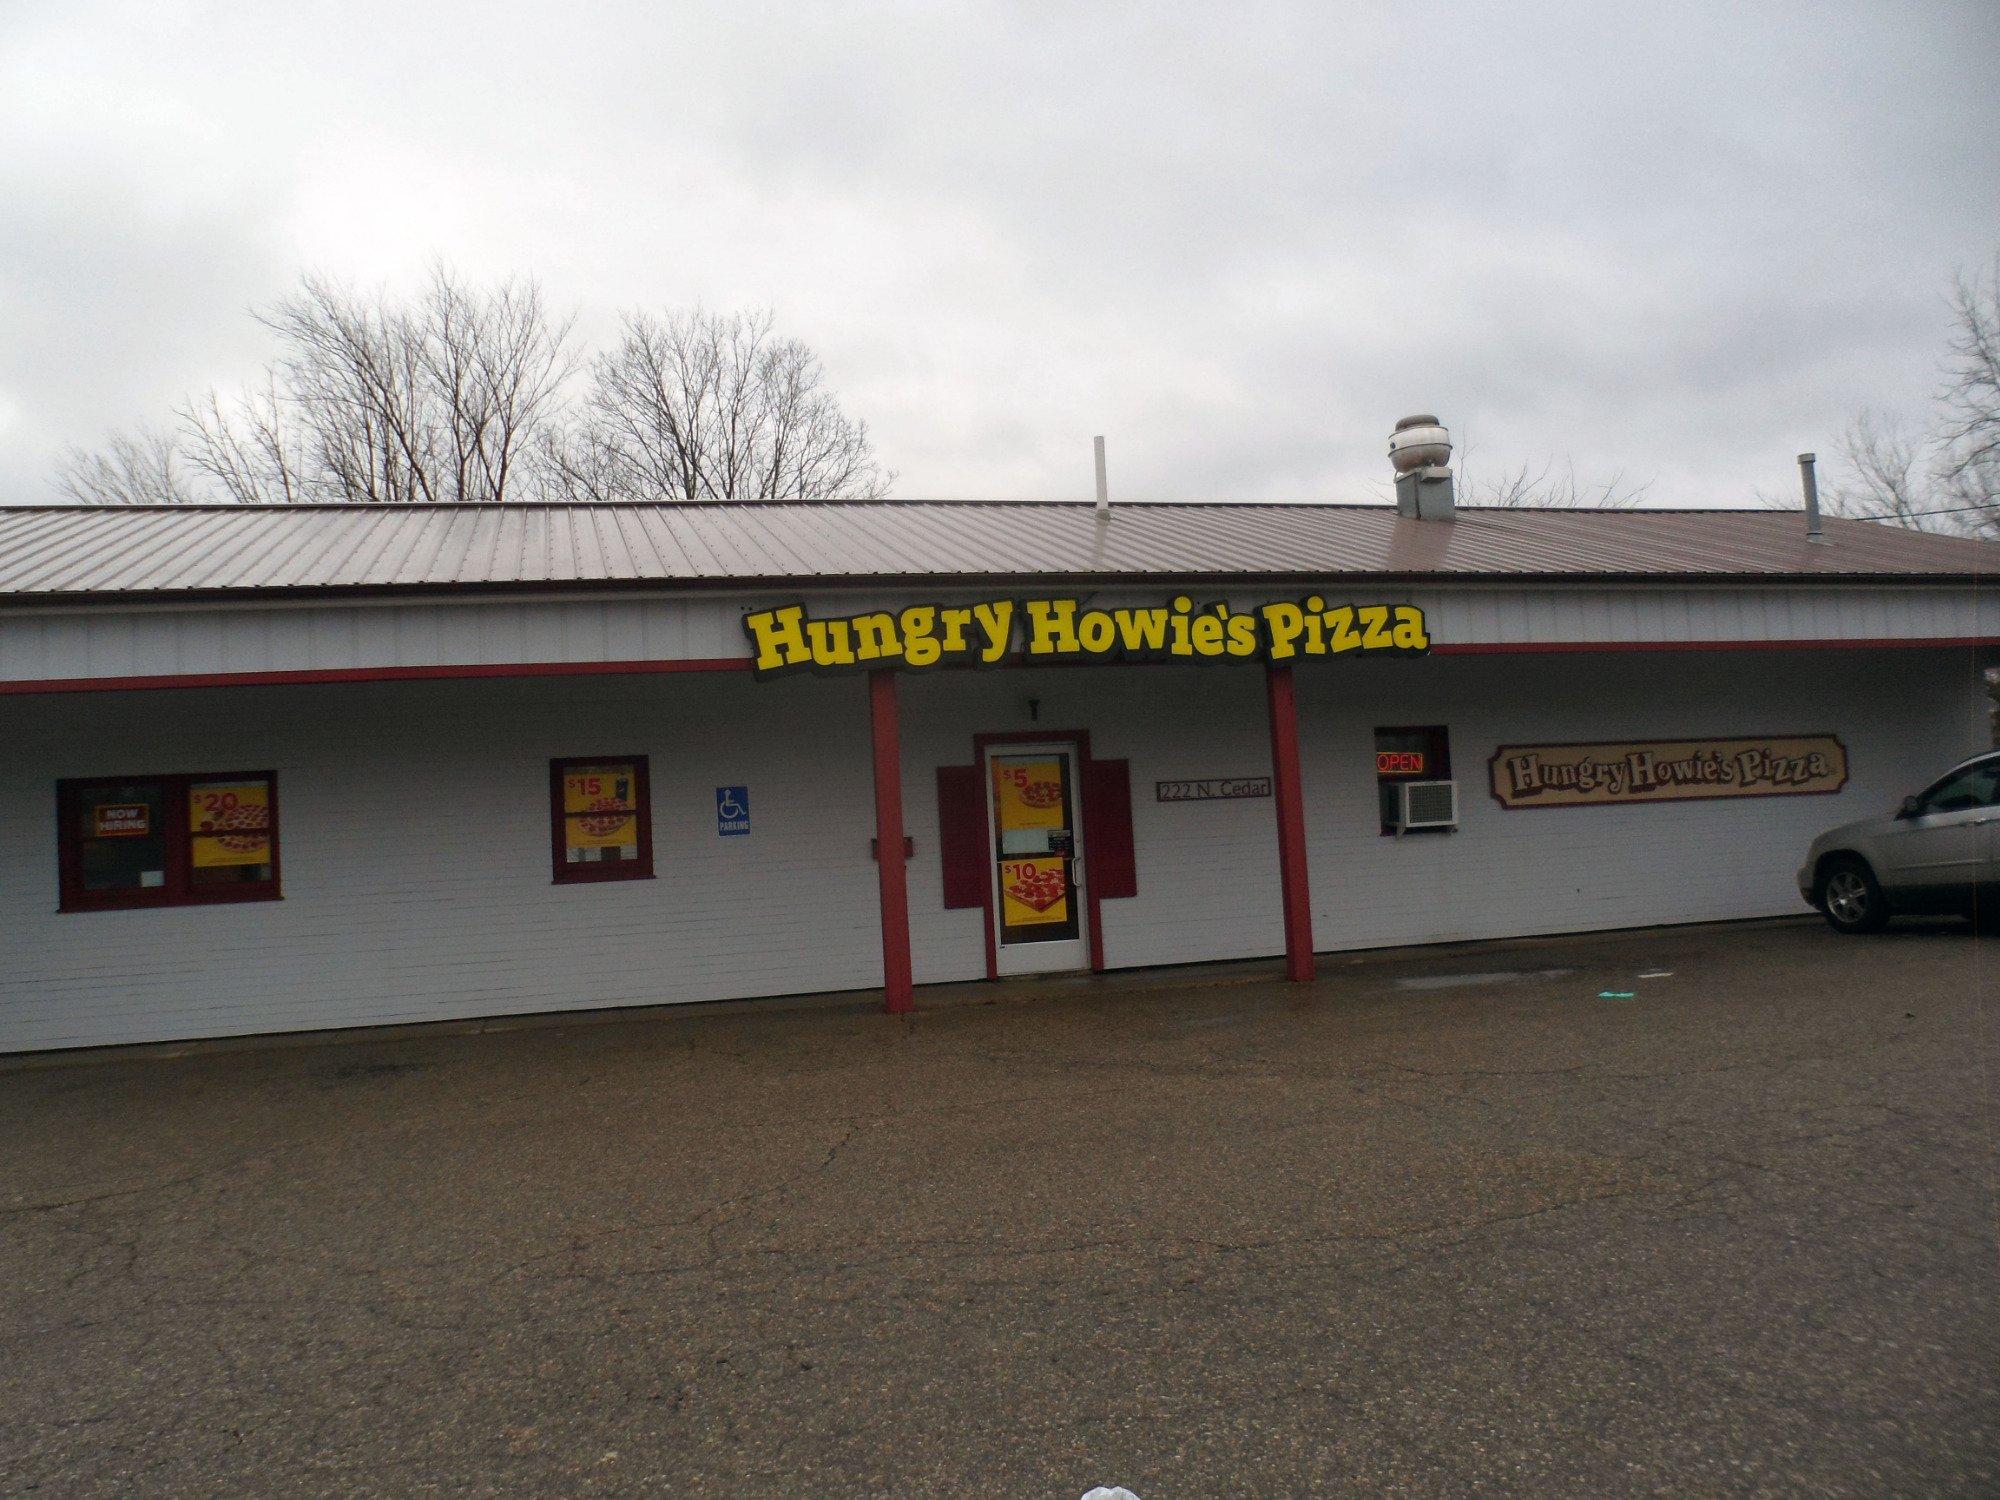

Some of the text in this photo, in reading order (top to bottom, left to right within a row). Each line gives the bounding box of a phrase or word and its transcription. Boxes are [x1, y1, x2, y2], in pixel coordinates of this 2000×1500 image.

[747, 596, 1427, 671] Hungry Howie's Pizza
[1377, 754, 1421, 771] OPEN
[1003, 768, 1029, 788] $5
[1508, 748, 1829, 796] Hungry Howie's Pizza
[568, 778, 602, 796] $15
[1161, 783, 1191, 798] 222
[1220, 780, 1268, 797] Cedar
[106, 808, 139, 820] NOW
[100, 819, 147, 831] HIRING
[719, 820, 749, 831] PARKING
[1004, 862, 1037, 880] $10
